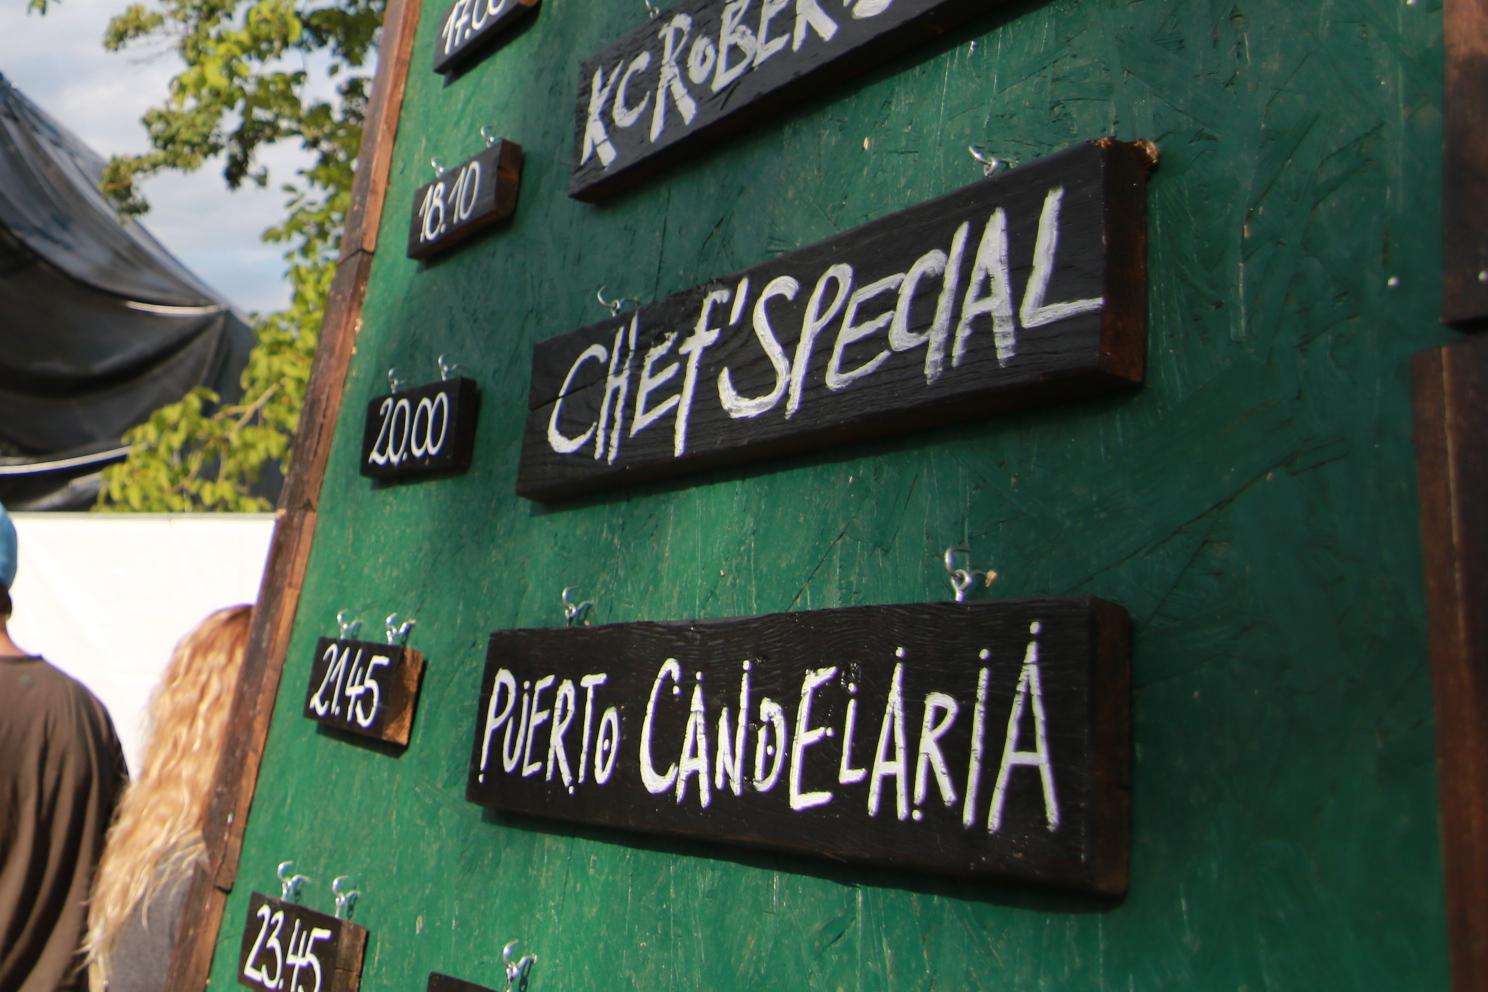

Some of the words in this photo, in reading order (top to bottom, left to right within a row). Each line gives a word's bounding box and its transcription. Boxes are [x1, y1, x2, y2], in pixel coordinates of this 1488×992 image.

[418, 160, 481, 244] 18.10
[368, 391, 449, 466] 20.00
[478, 668, 622, 795] PUERTO
[639, 620, 1061, 833] CANDELARIA
[243, 903, 332, 992] 23.45
